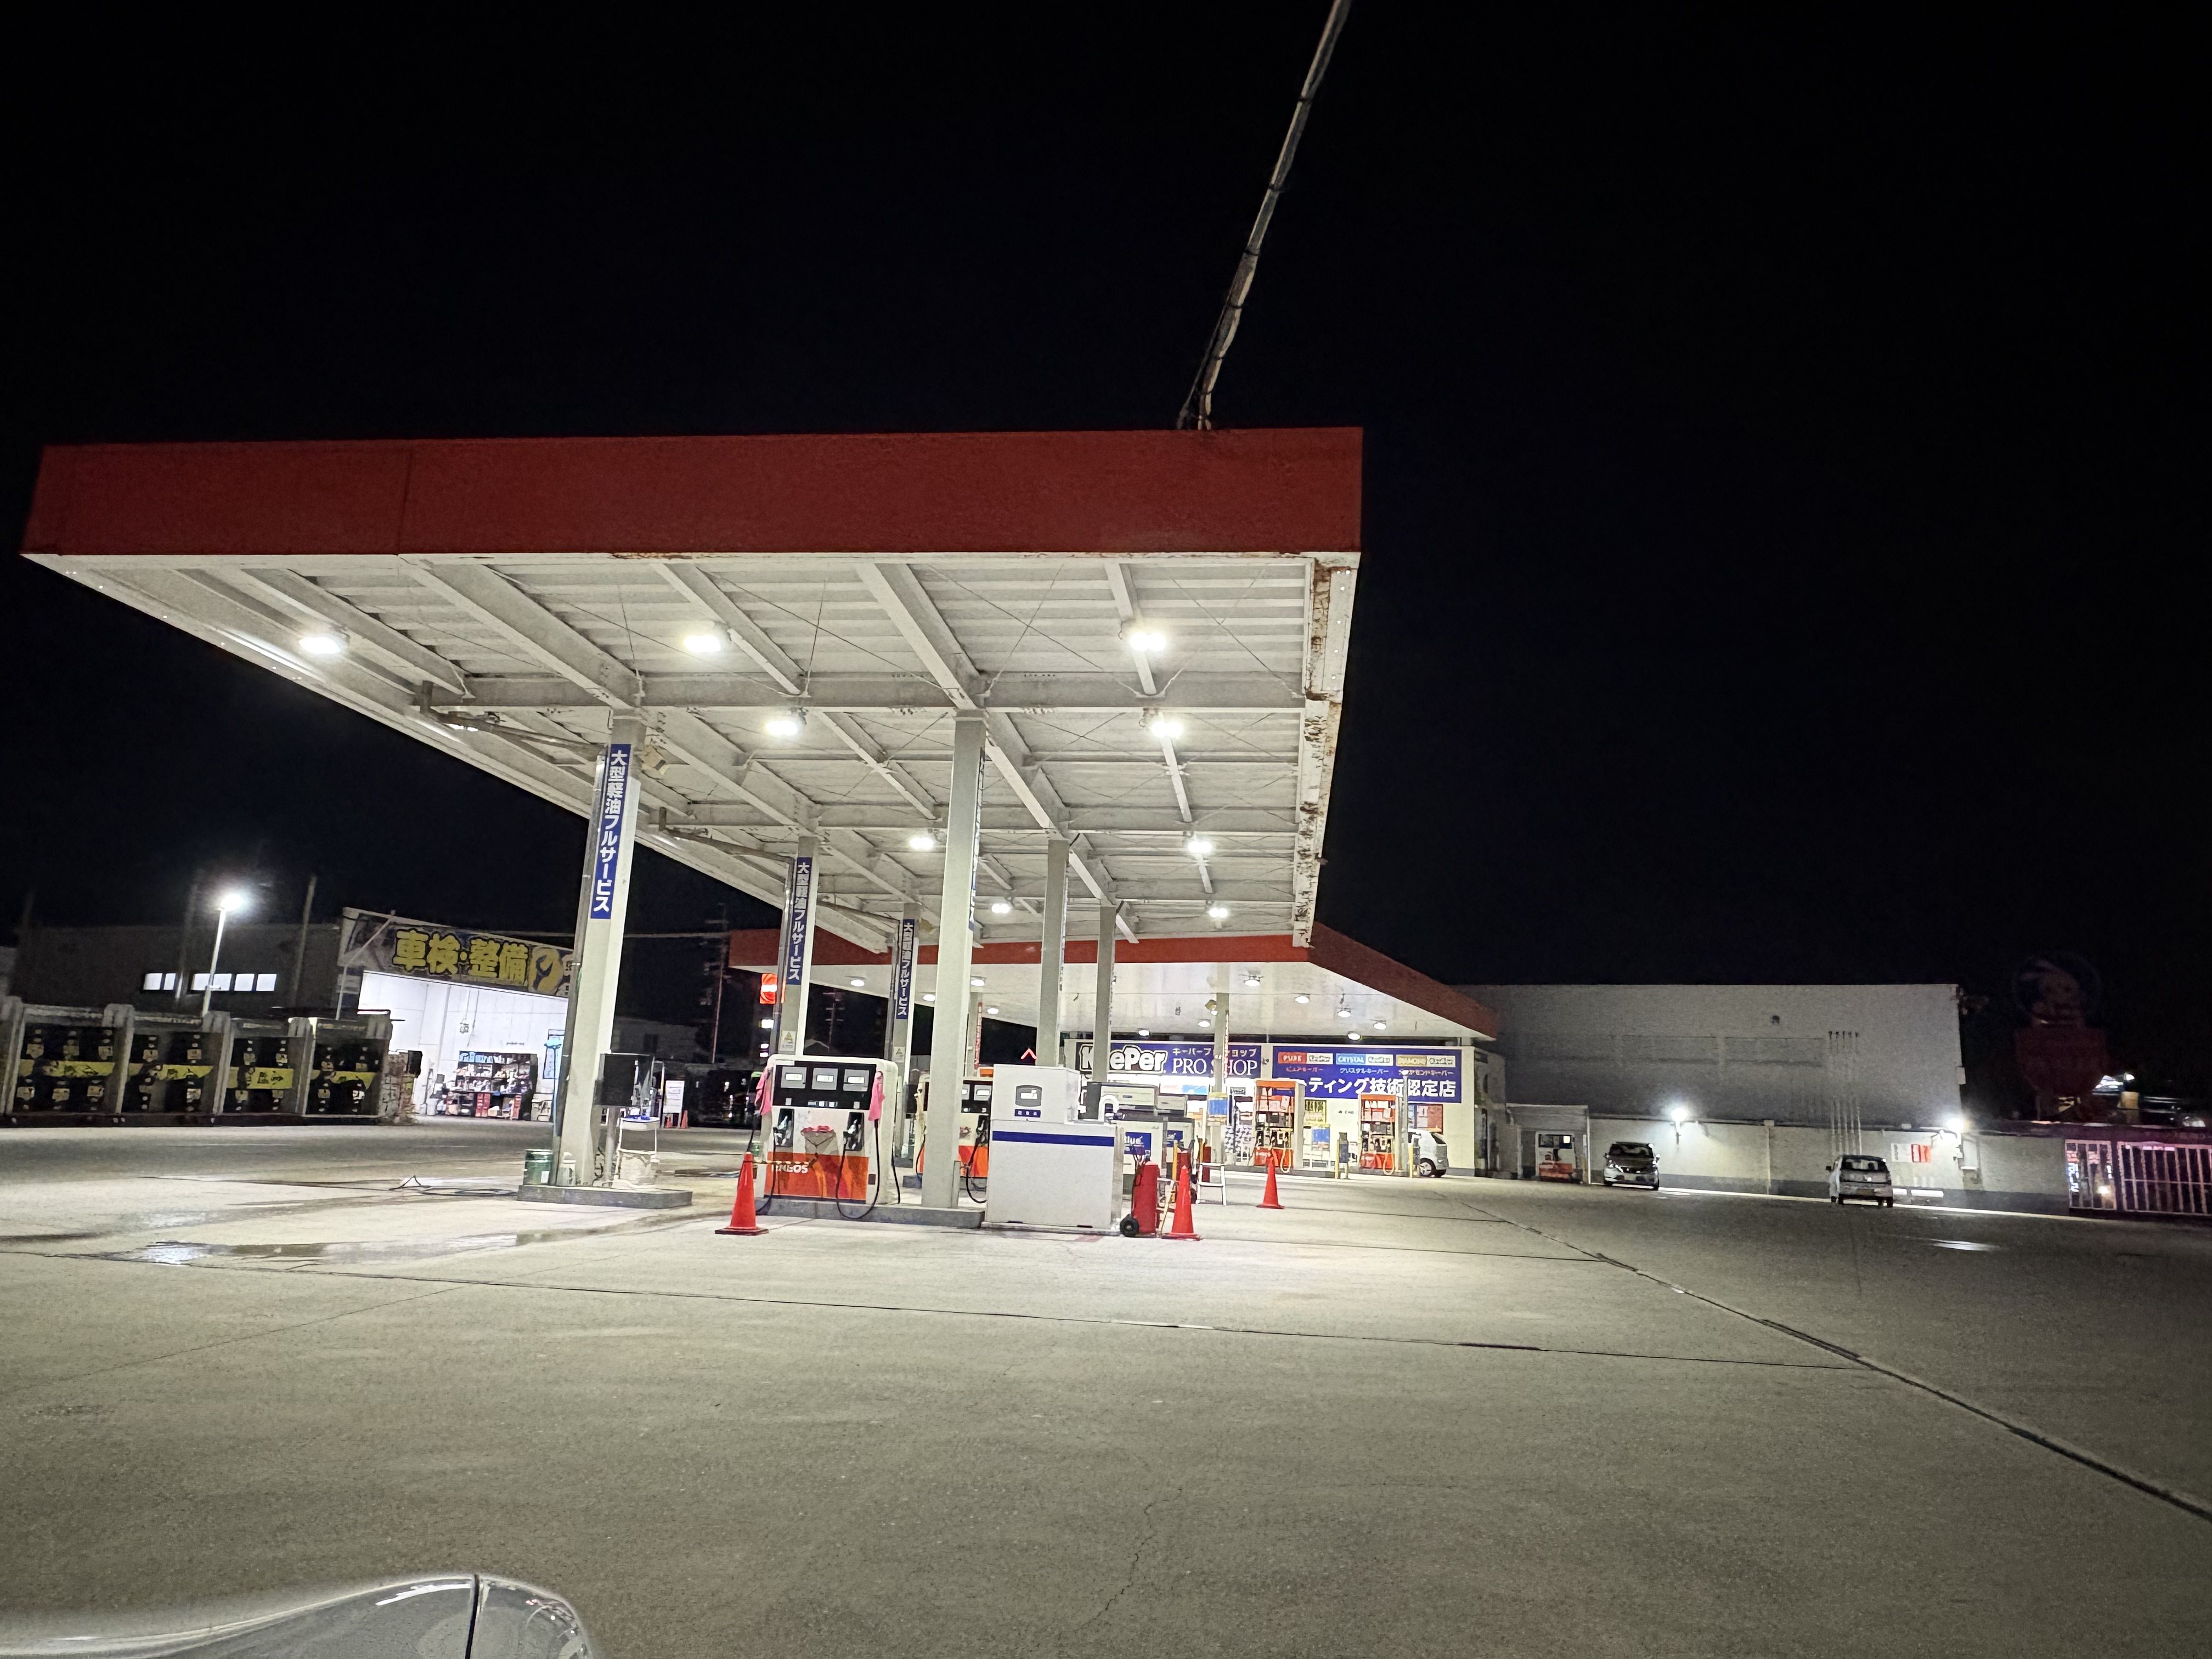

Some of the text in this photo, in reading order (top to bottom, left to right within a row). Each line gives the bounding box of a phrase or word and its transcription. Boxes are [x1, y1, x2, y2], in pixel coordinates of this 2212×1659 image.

[1081, 1045, 1167, 1073] KePer
[1171, 1058, 1207, 1074] PRO
[1308, 1077, 1457, 1097] ティング技術認定店
